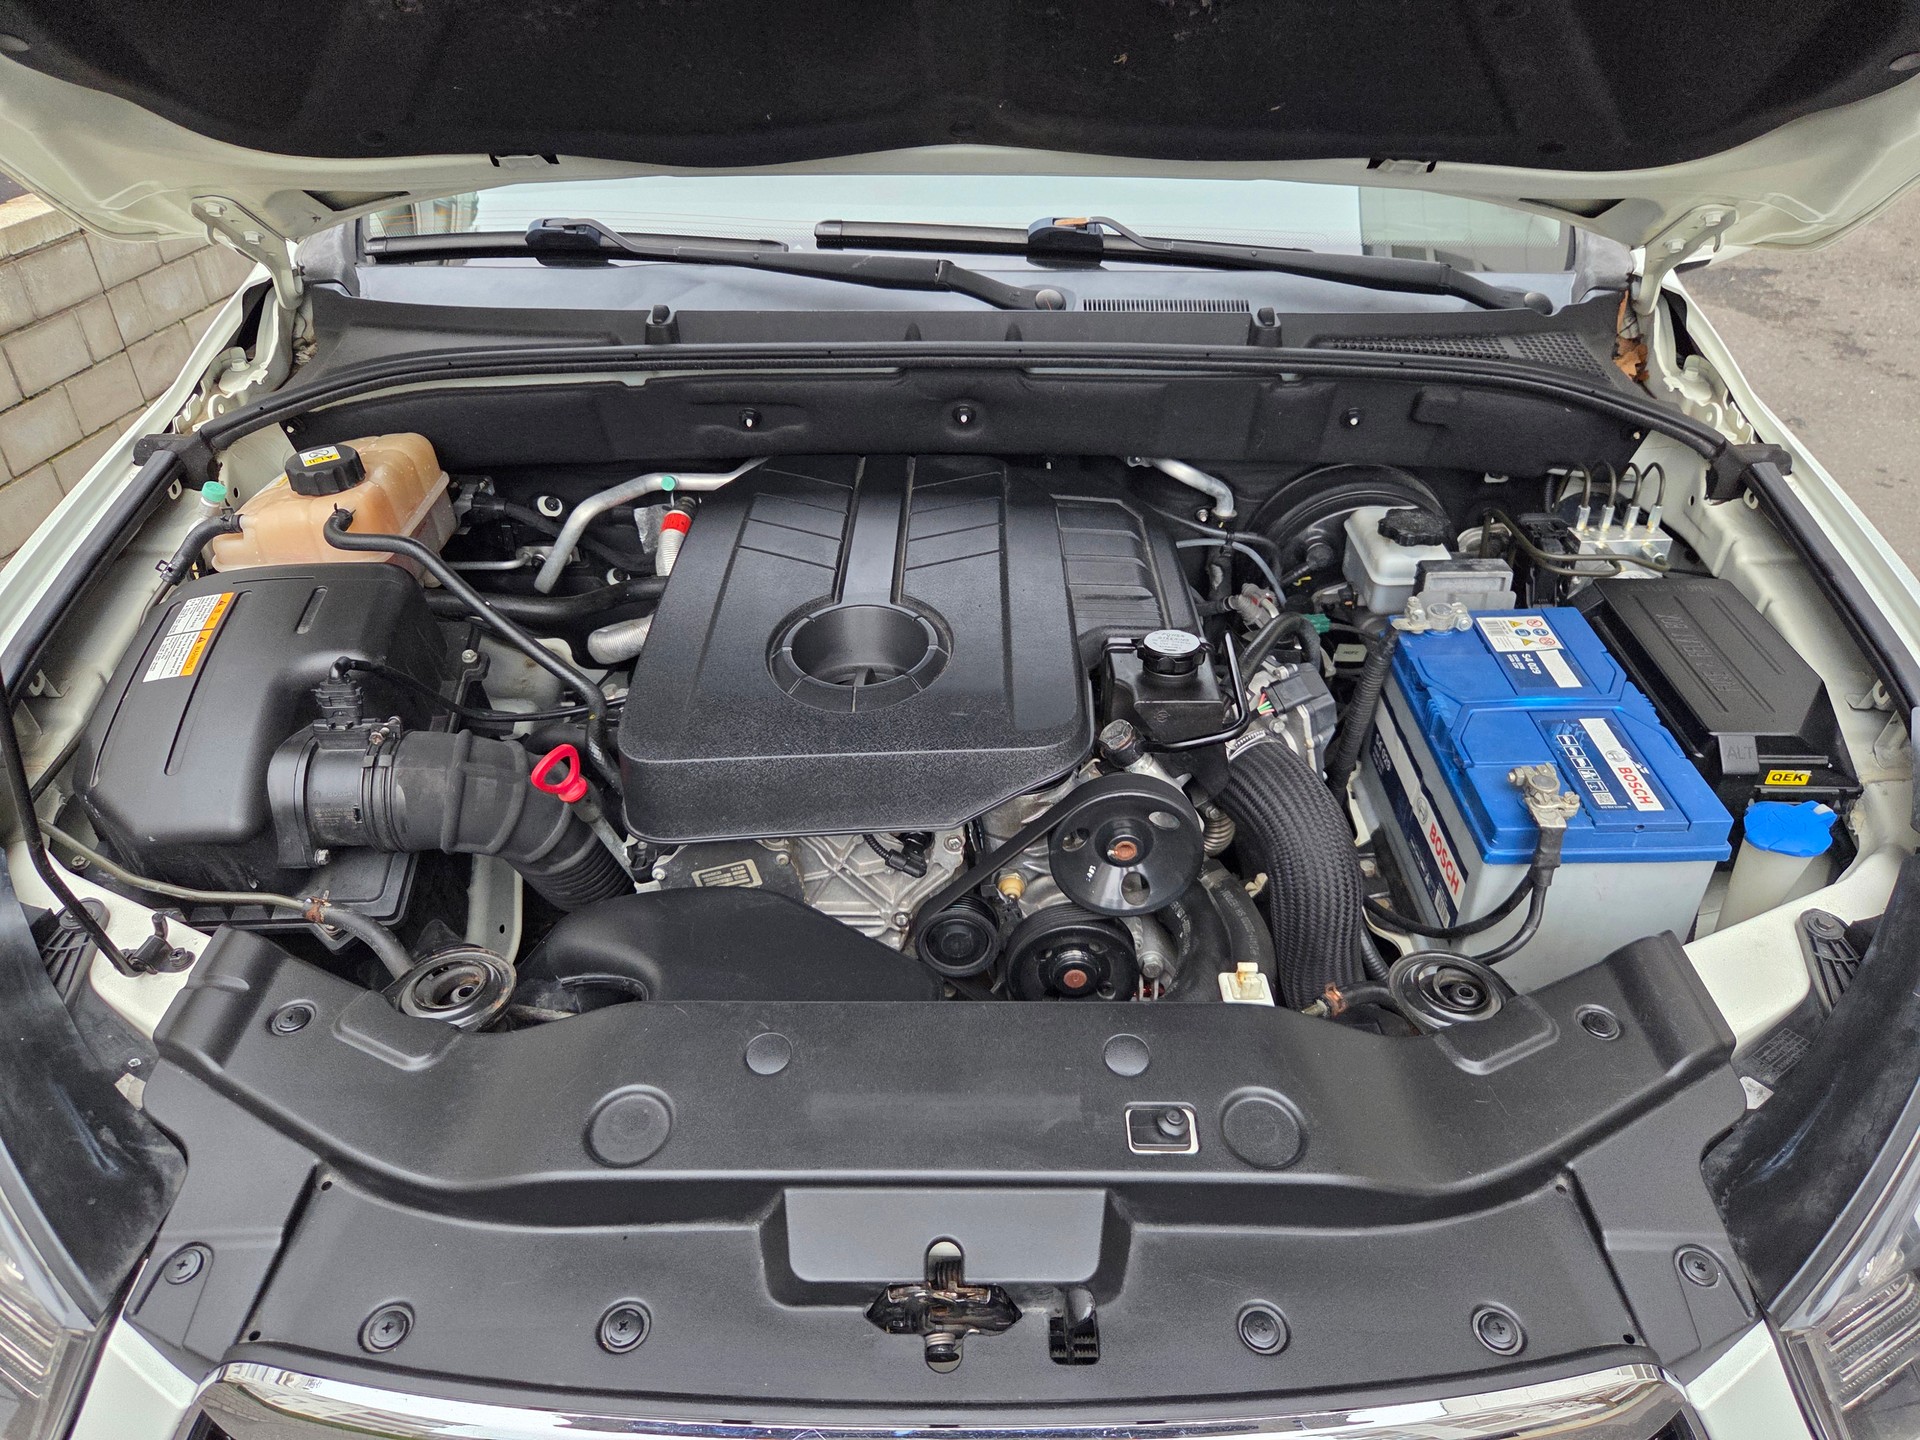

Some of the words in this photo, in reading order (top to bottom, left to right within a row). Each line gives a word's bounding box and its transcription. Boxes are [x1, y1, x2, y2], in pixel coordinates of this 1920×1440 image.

[1726, 745, 1755, 761] ALT
[1616, 766, 1655, 806] BOSCH
[1771, 773, 1804, 783] QEK
[1428, 821, 1461, 897] BOSCH
